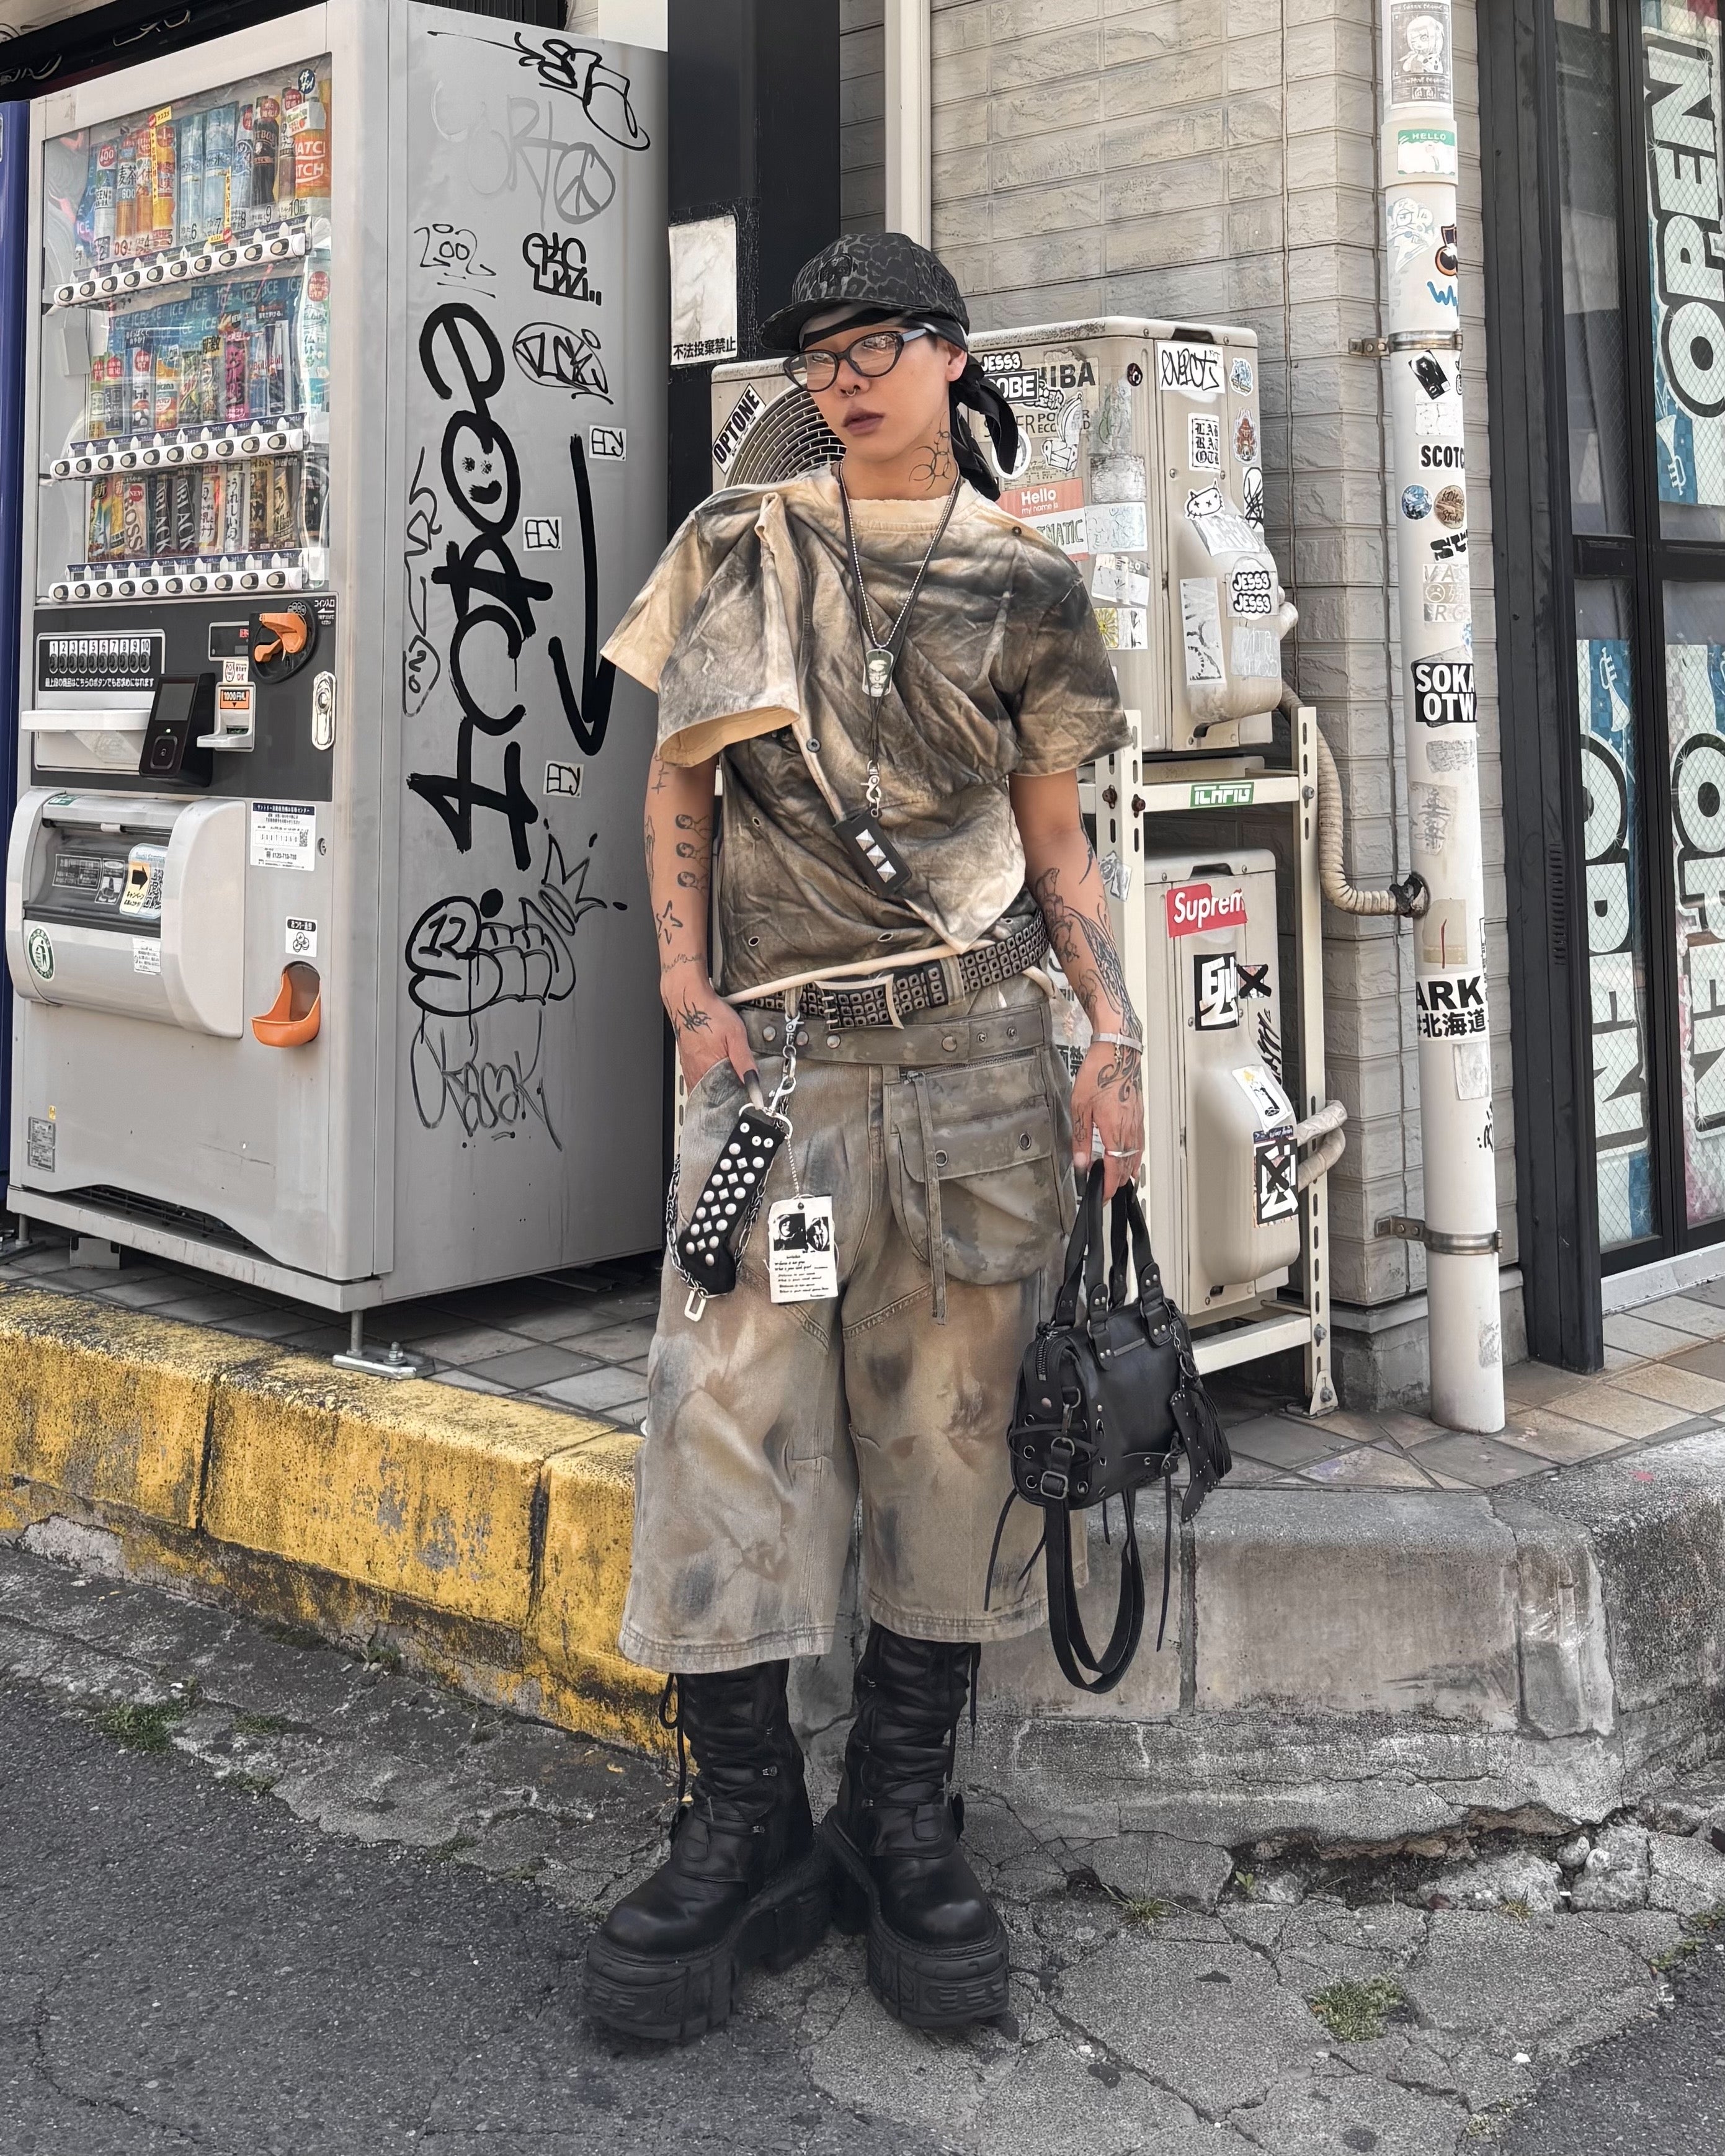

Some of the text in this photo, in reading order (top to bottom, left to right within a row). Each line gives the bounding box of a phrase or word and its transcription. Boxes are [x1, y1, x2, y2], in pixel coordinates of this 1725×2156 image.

[1412, 132, 1446, 141] HELLO
[100, 150, 114, 161] 600
[118, 166, 136, 185] 麦茶
[122, 188, 135, 198] 600
[1647, 46, 1725, 405] OPEN
[674, 336, 736, 360] 不法投棄禁止
[982, 353, 1021, 372] JESS3
[989, 375, 1035, 399] OBE
[713, 389, 760, 465] OPTONE
[1021, 488, 1057, 506] Hello
[124, 496, 143, 551] BOSS
[156, 486, 171, 553] BLACK
[177, 483, 195, 551] BLACK
[1233, 572, 1270, 590] JESS3
[1234, 594, 1271, 612] JESS3
[61, 643, 66, 652] 2
[71, 642, 76, 652] 3
[81, 642, 86, 651] 4
[91, 641, 96, 651] 5
[101, 641, 106, 651] 6
[112, 641, 117, 651] 7
[122, 641, 127, 651] 8
[132, 641, 138, 651] 9
[141, 641, 150, 651] 10
